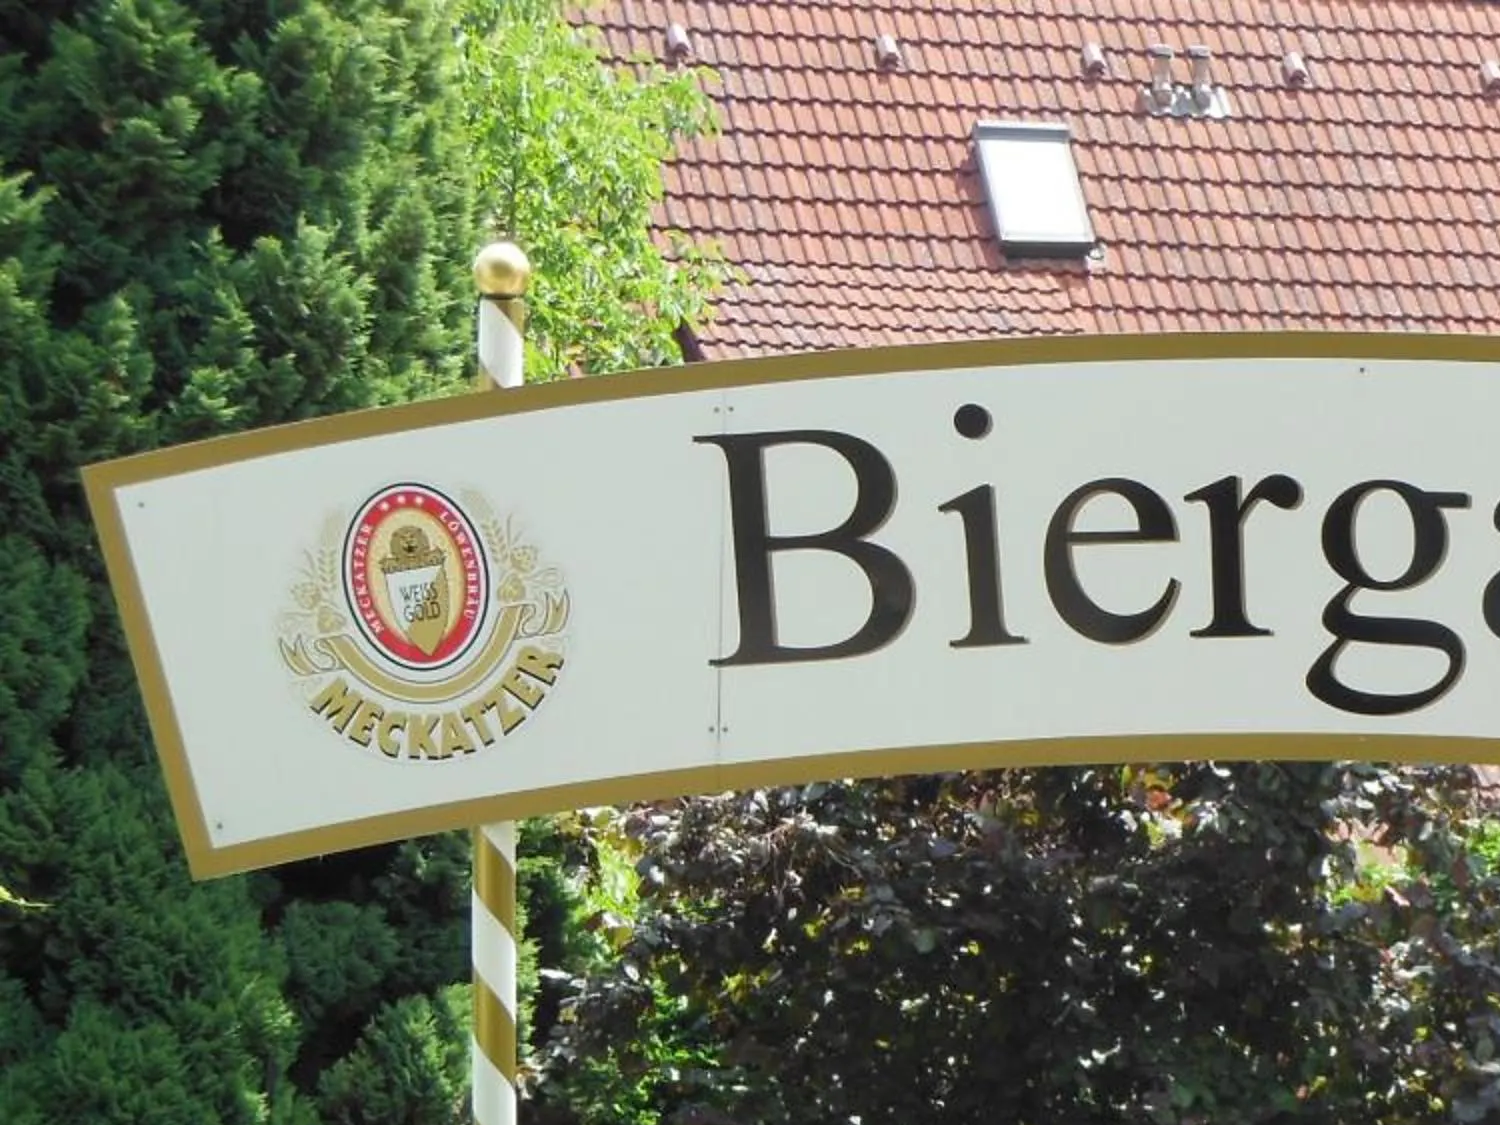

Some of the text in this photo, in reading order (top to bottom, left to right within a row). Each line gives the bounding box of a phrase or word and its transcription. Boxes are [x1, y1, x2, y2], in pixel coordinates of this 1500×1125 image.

[399, 581, 438, 603] WEISS
[403, 601, 441, 623] GOLD
[310, 645, 564, 760] MECKATZER
